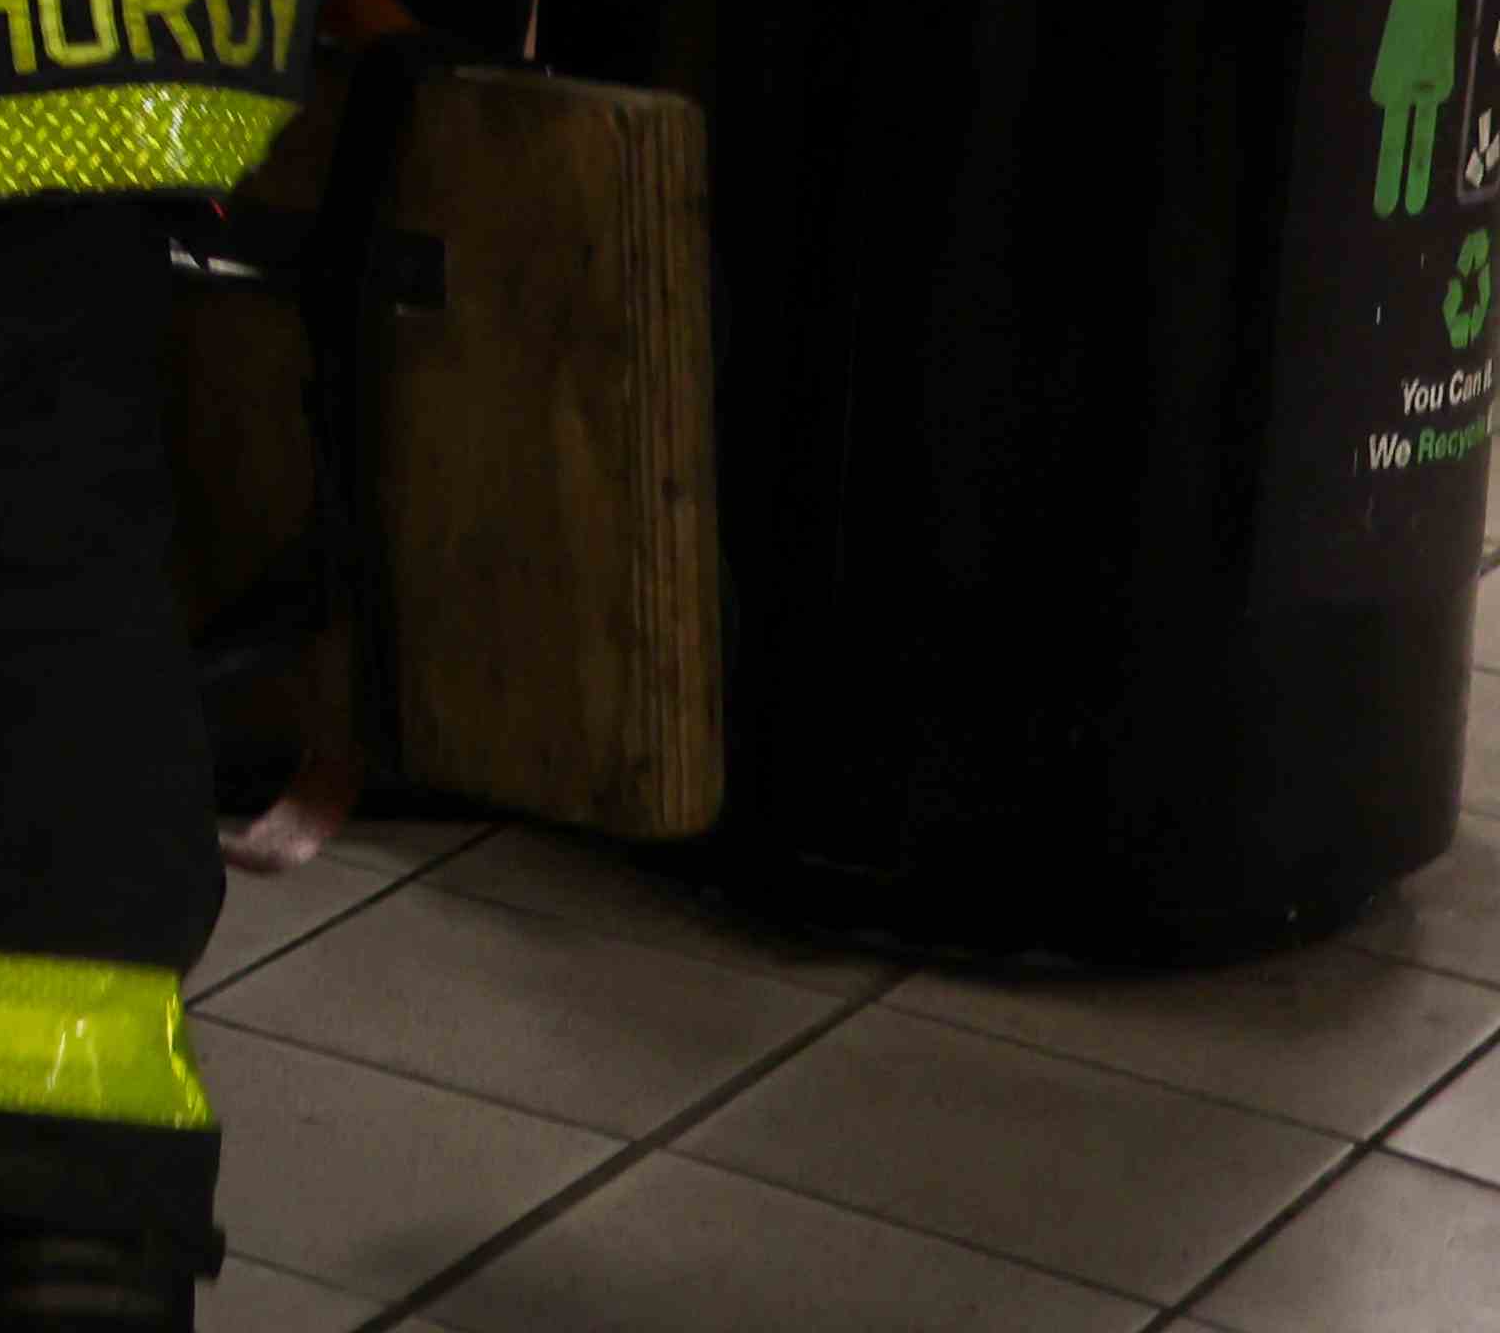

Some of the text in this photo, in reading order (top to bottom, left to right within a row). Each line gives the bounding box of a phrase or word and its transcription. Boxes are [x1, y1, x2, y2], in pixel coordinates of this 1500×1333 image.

[1401, 376, 1445, 416] You
[1368, 433, 1412, 470] We
[1417, 417, 1485, 464] Recy
